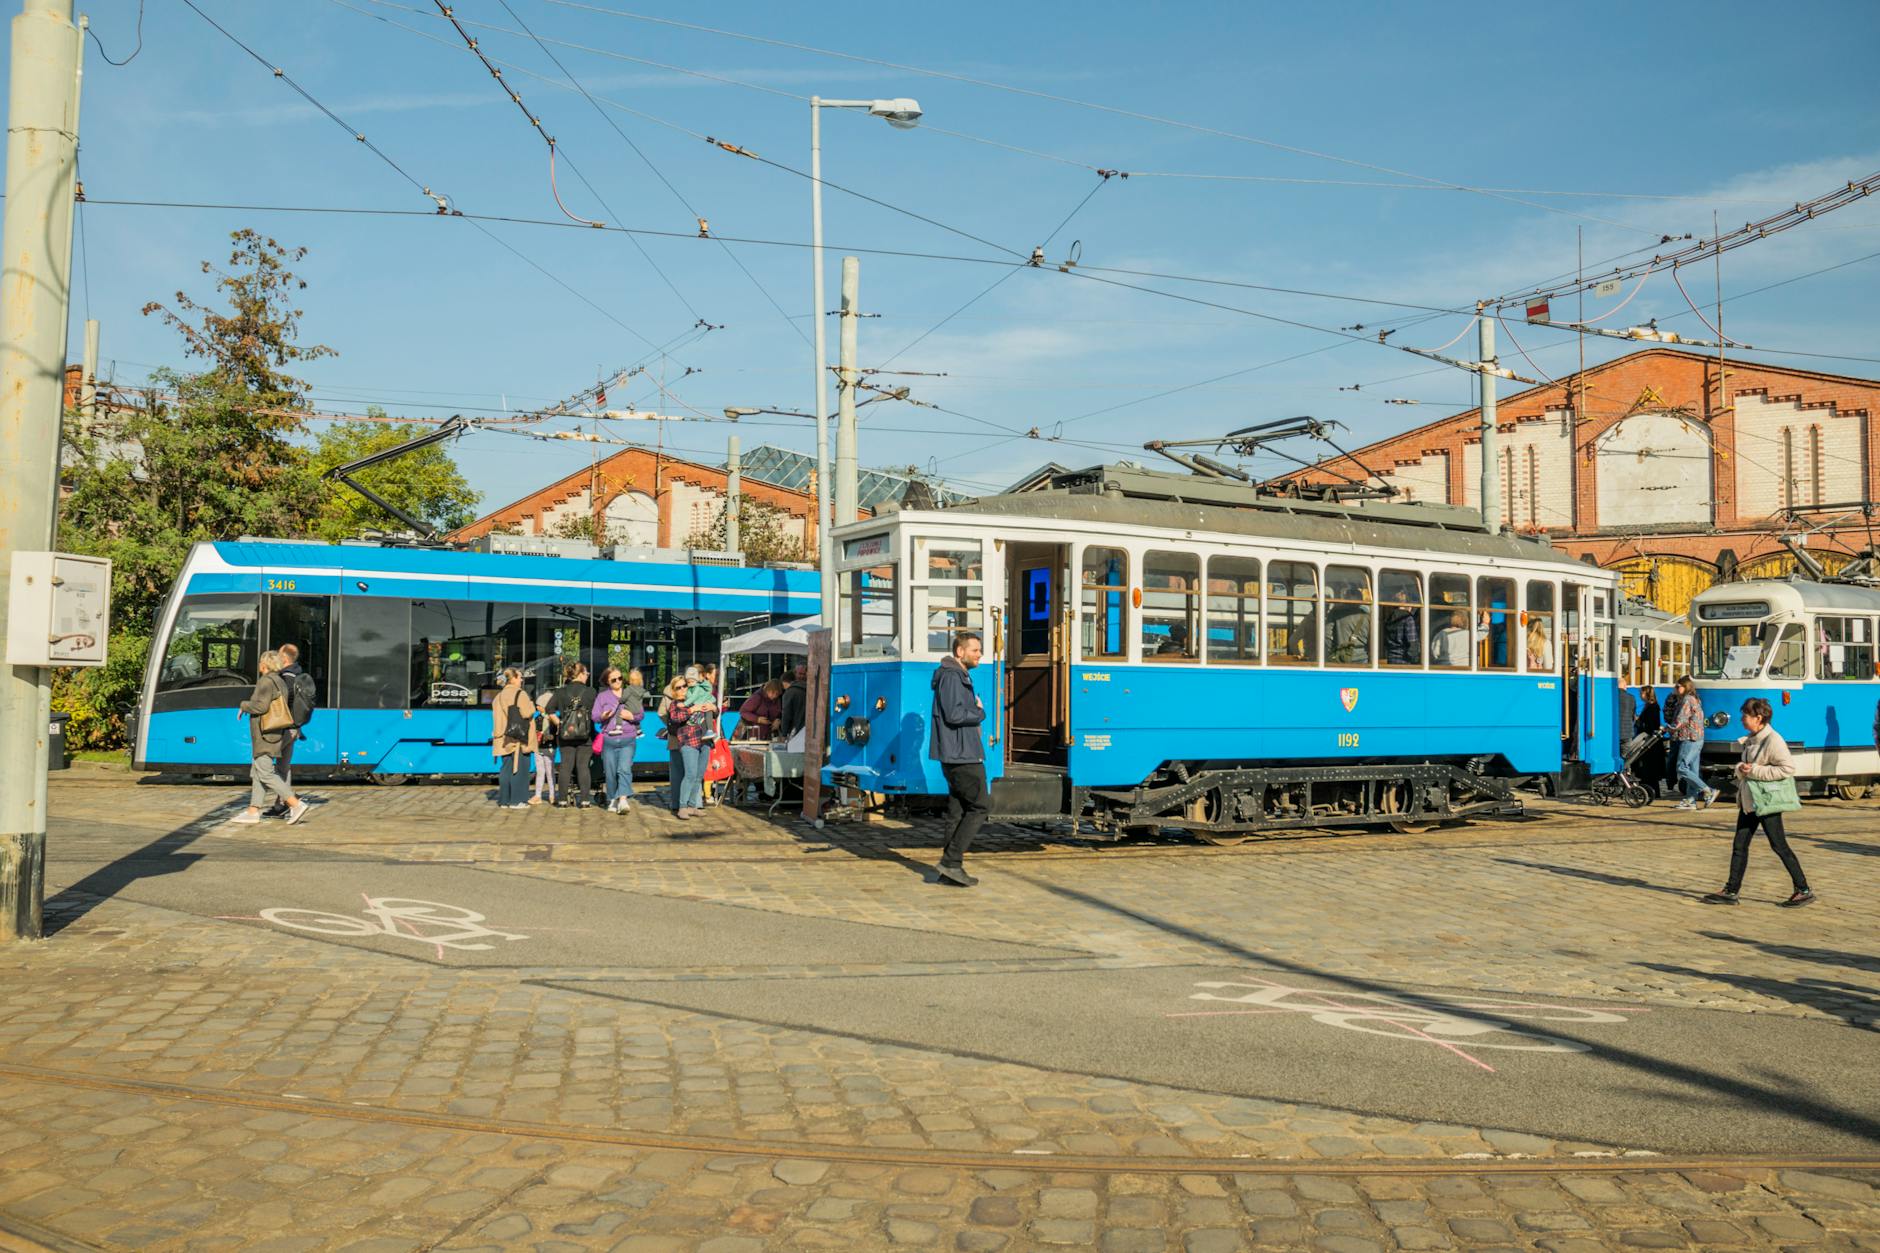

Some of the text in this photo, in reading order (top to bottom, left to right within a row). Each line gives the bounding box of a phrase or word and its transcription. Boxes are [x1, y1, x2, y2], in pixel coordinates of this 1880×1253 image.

[267, 579, 296, 590] 3416
[431, 689, 468, 698] pesa
[1338, 733, 1360, 747] 1192
